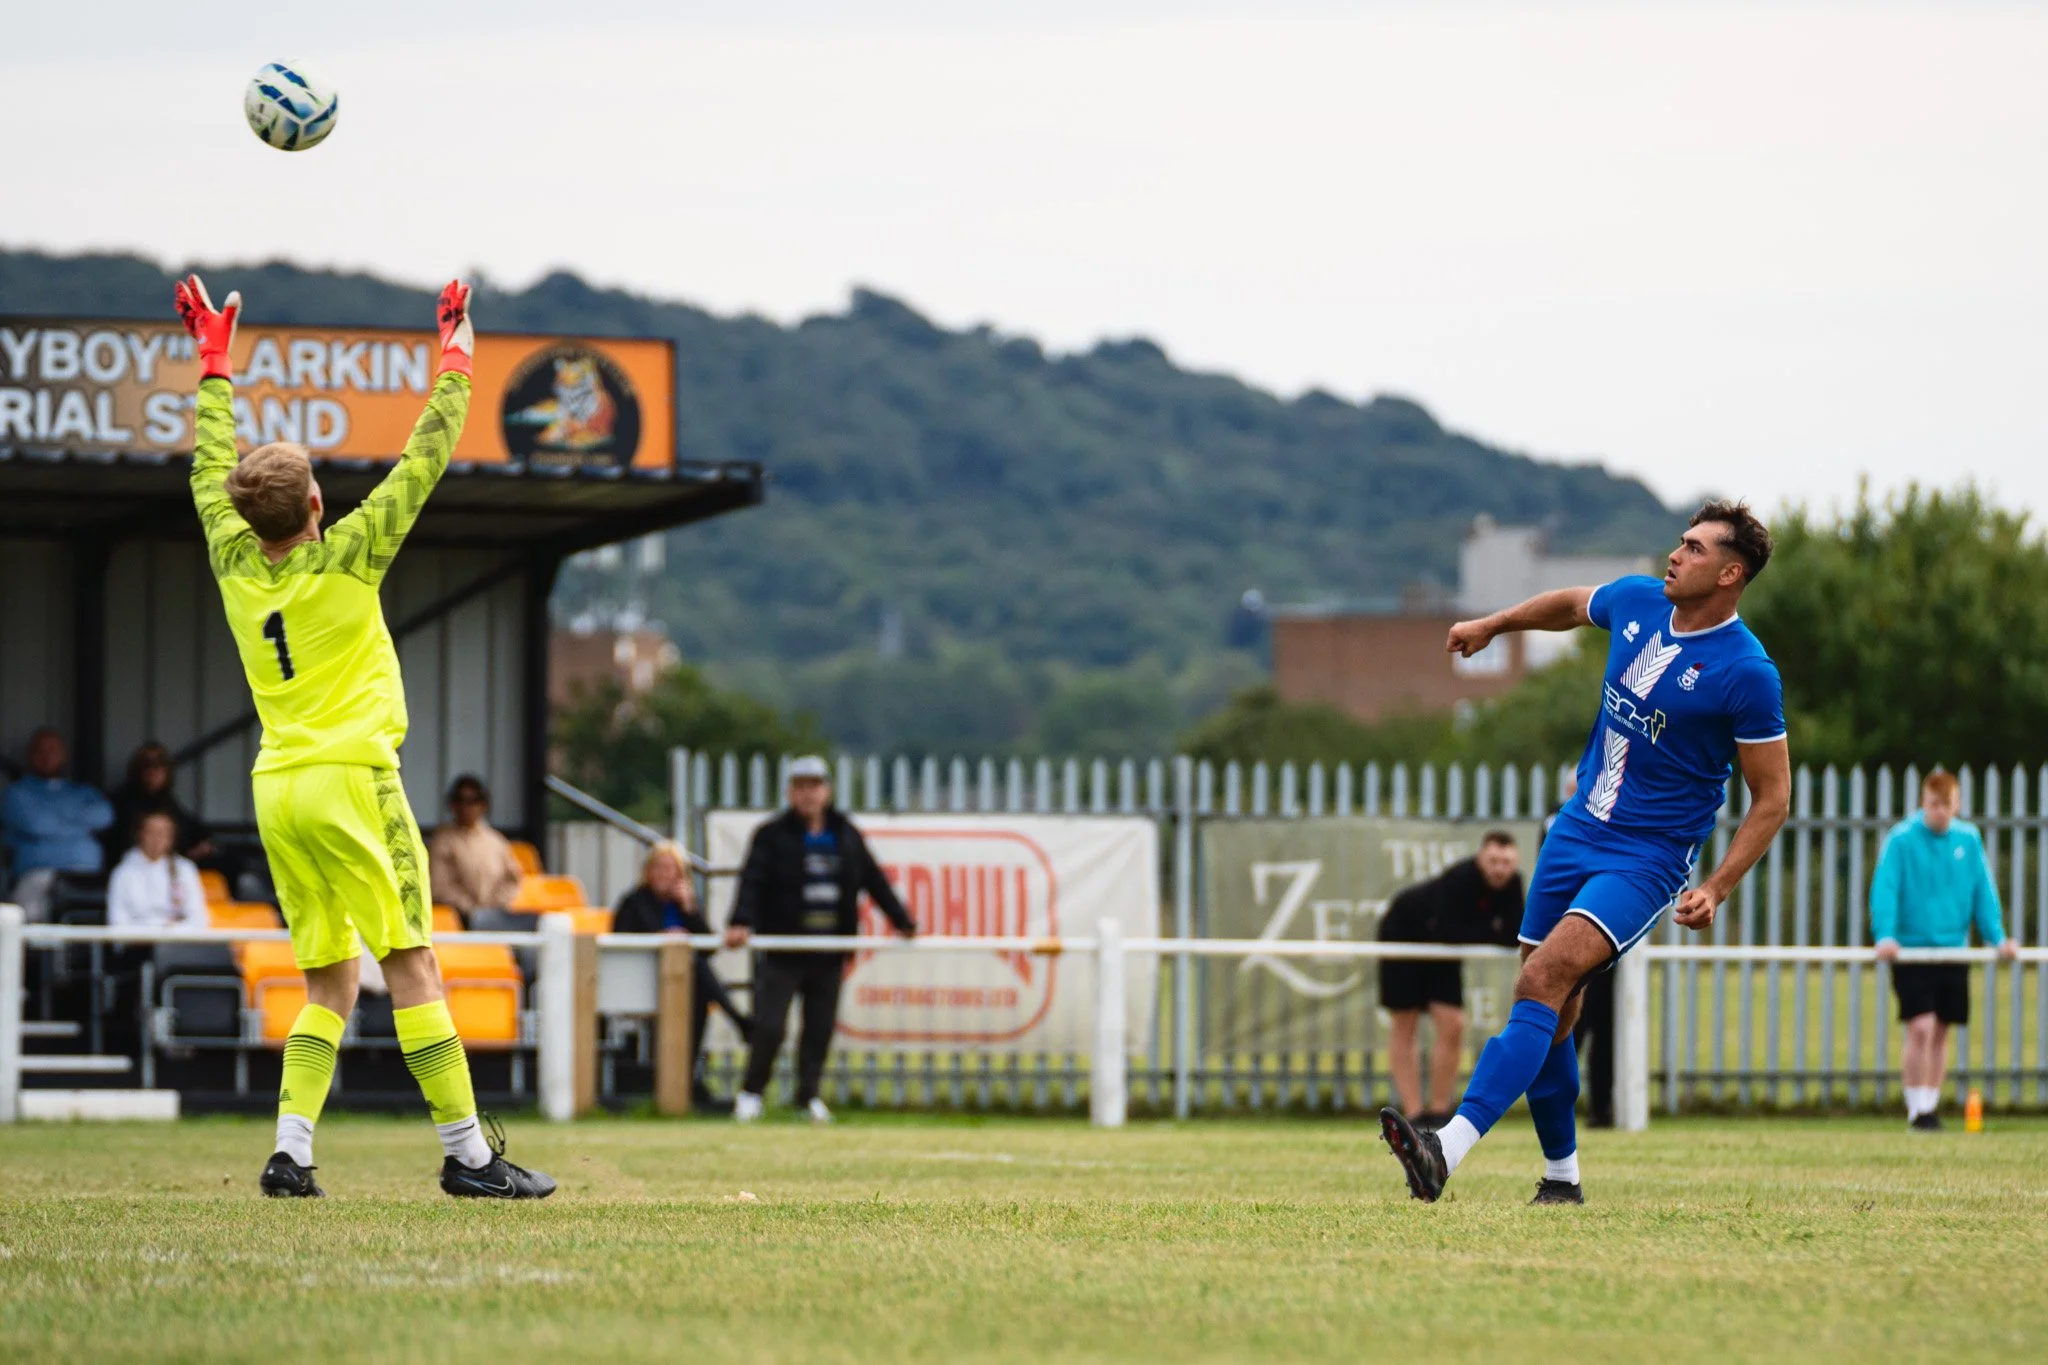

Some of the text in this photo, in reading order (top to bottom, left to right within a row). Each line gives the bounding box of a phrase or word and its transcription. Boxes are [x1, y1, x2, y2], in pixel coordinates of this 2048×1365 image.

[231, 337, 428, 394] ARKIN
[145, 392, 347, 448] SAND
[262, 610, 296, 681] 1
[843, 864, 1032, 986] DHILL
